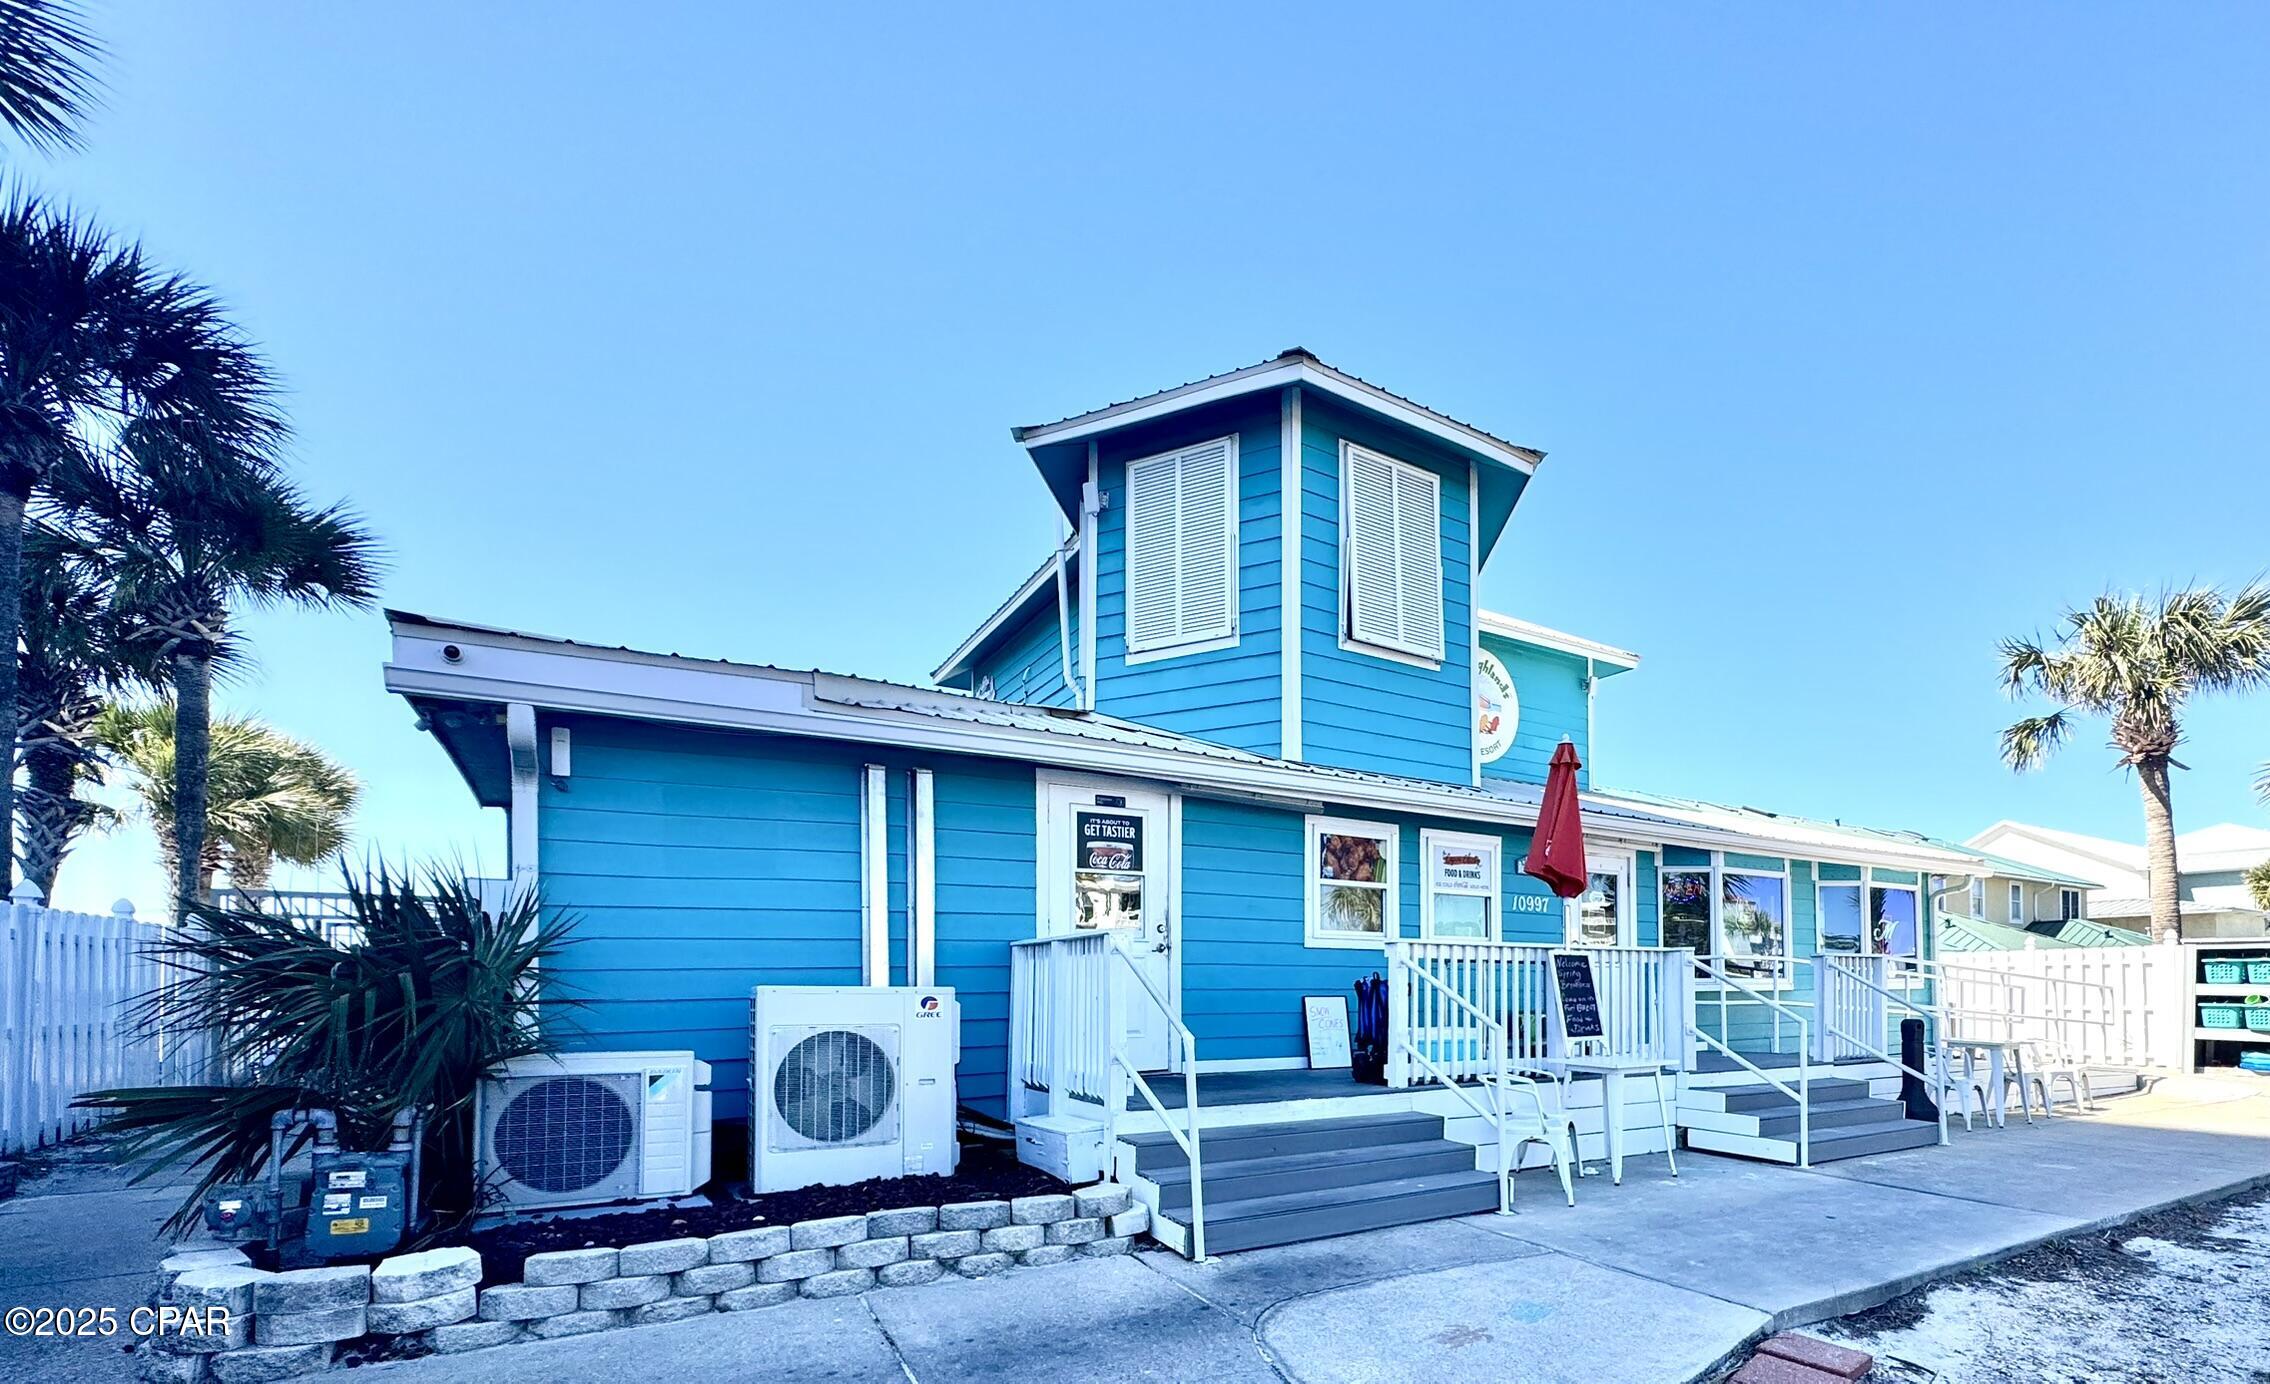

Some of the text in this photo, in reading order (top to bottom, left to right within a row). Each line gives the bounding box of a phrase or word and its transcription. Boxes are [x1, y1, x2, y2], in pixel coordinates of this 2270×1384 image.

[1478, 660, 1510, 699] ghlands
[1481, 739, 1502, 756] ESORT
[1084, 824, 1136, 839] GET TASTIER
[1444, 868, 1457, 878] FOOD
[1463, 870, 1481, 879] DRINKS
[1512, 895, 1549, 913] 10997
